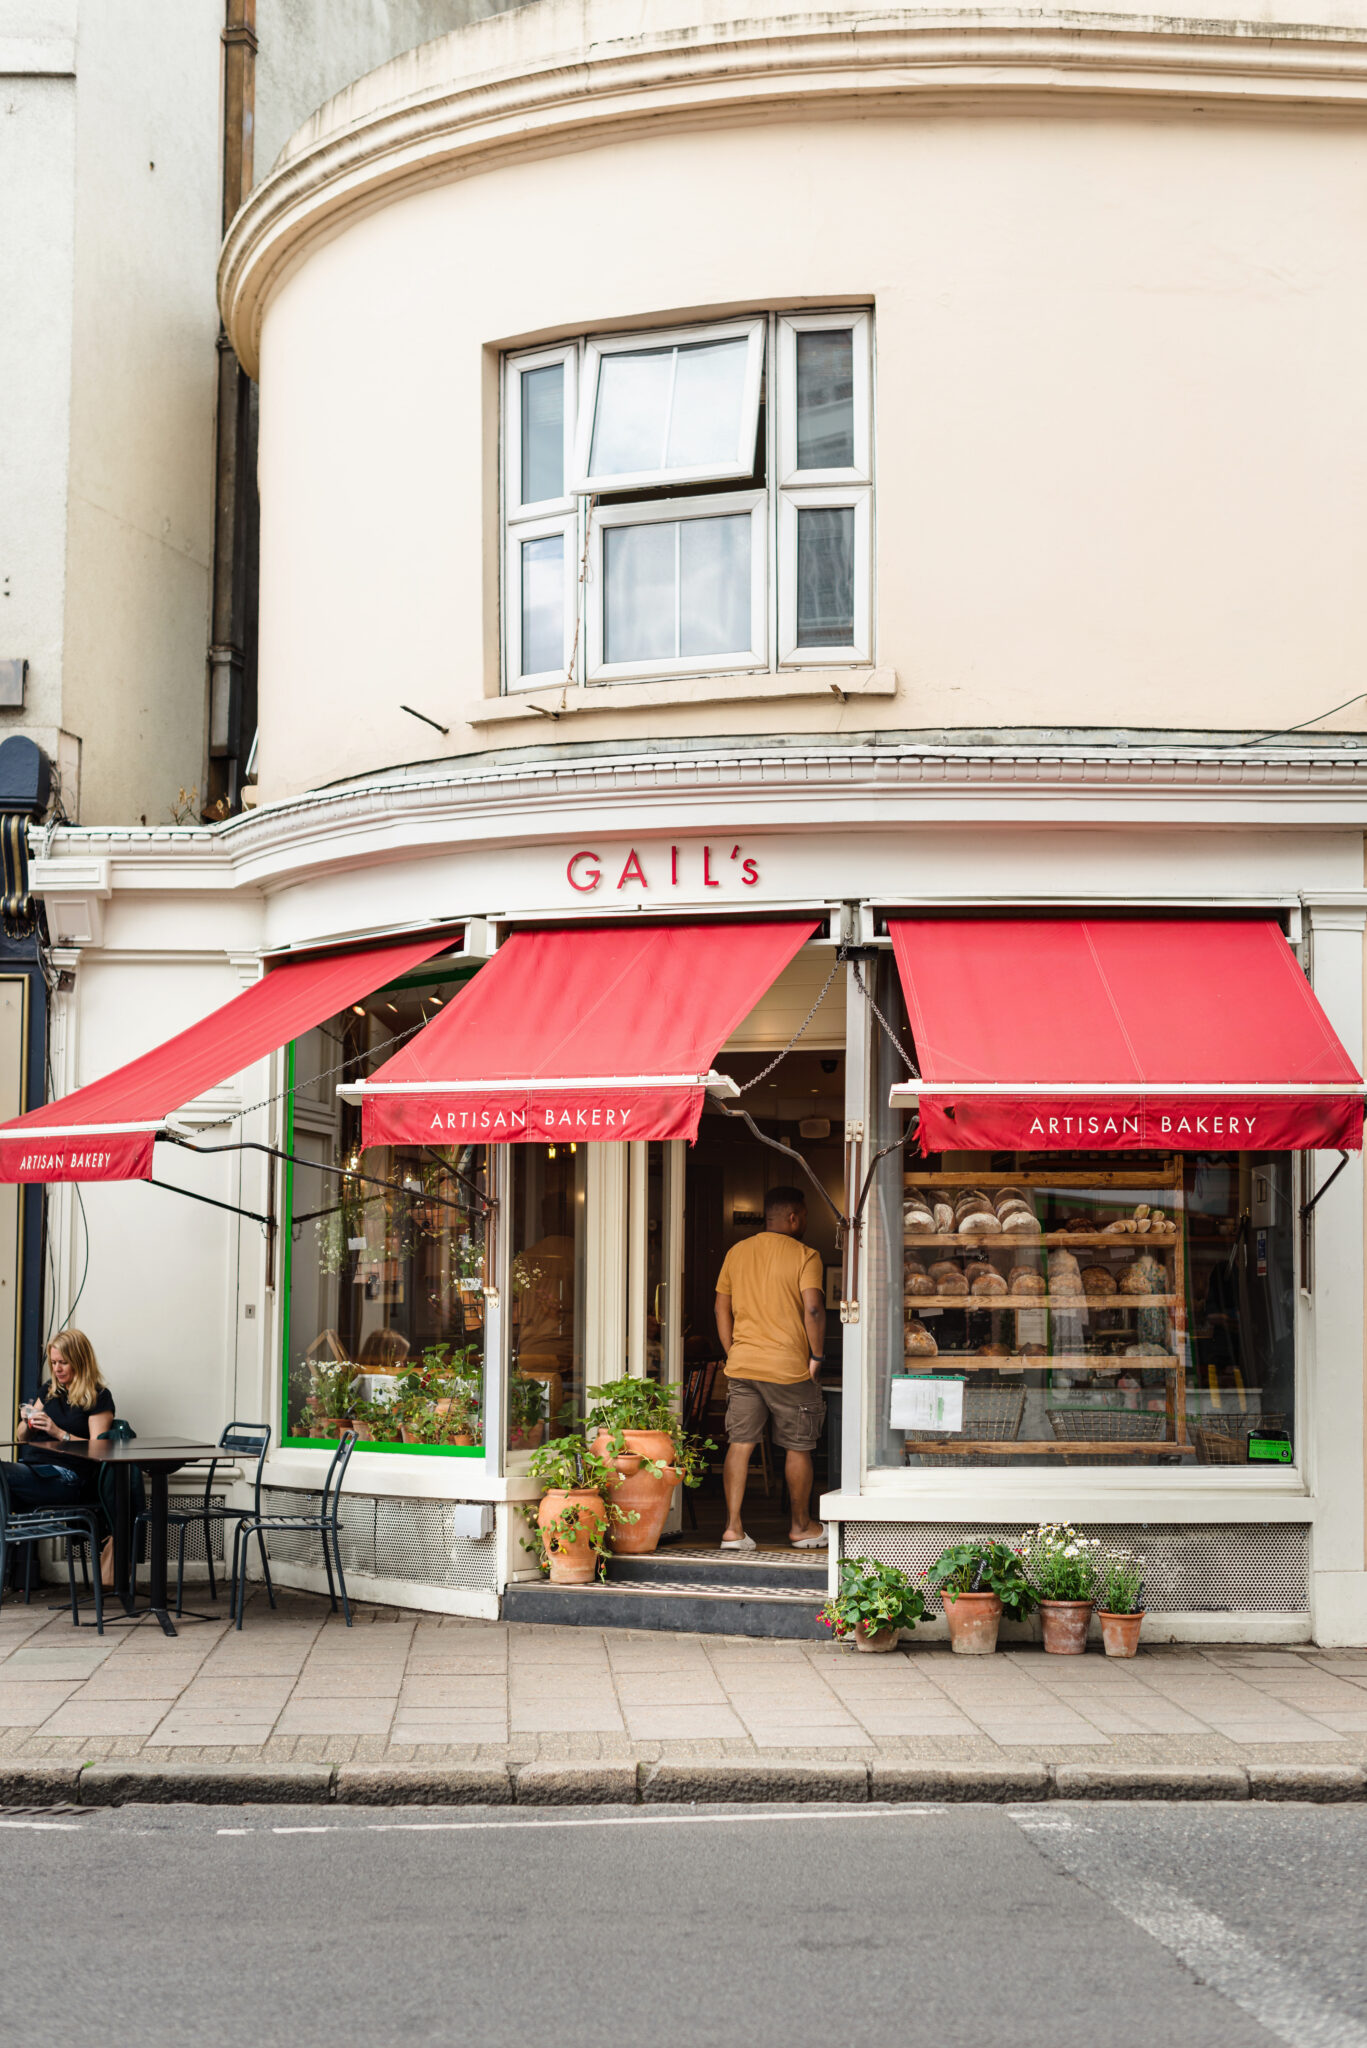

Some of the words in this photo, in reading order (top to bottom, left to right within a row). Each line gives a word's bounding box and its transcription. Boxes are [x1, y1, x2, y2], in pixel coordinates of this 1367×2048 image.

[566, 844, 760, 892] GAIL's
[429, 1111, 527, 1129] ARTISAN
[544, 1109, 632, 1126] BAKERY
[1029, 1116, 1139, 1134] ARTISAN
[1161, 1116, 1257, 1134] BAKERY
[19, 1154, 65, 1171] ARTISAN
[70, 1152, 112, 1168] BAKERY
